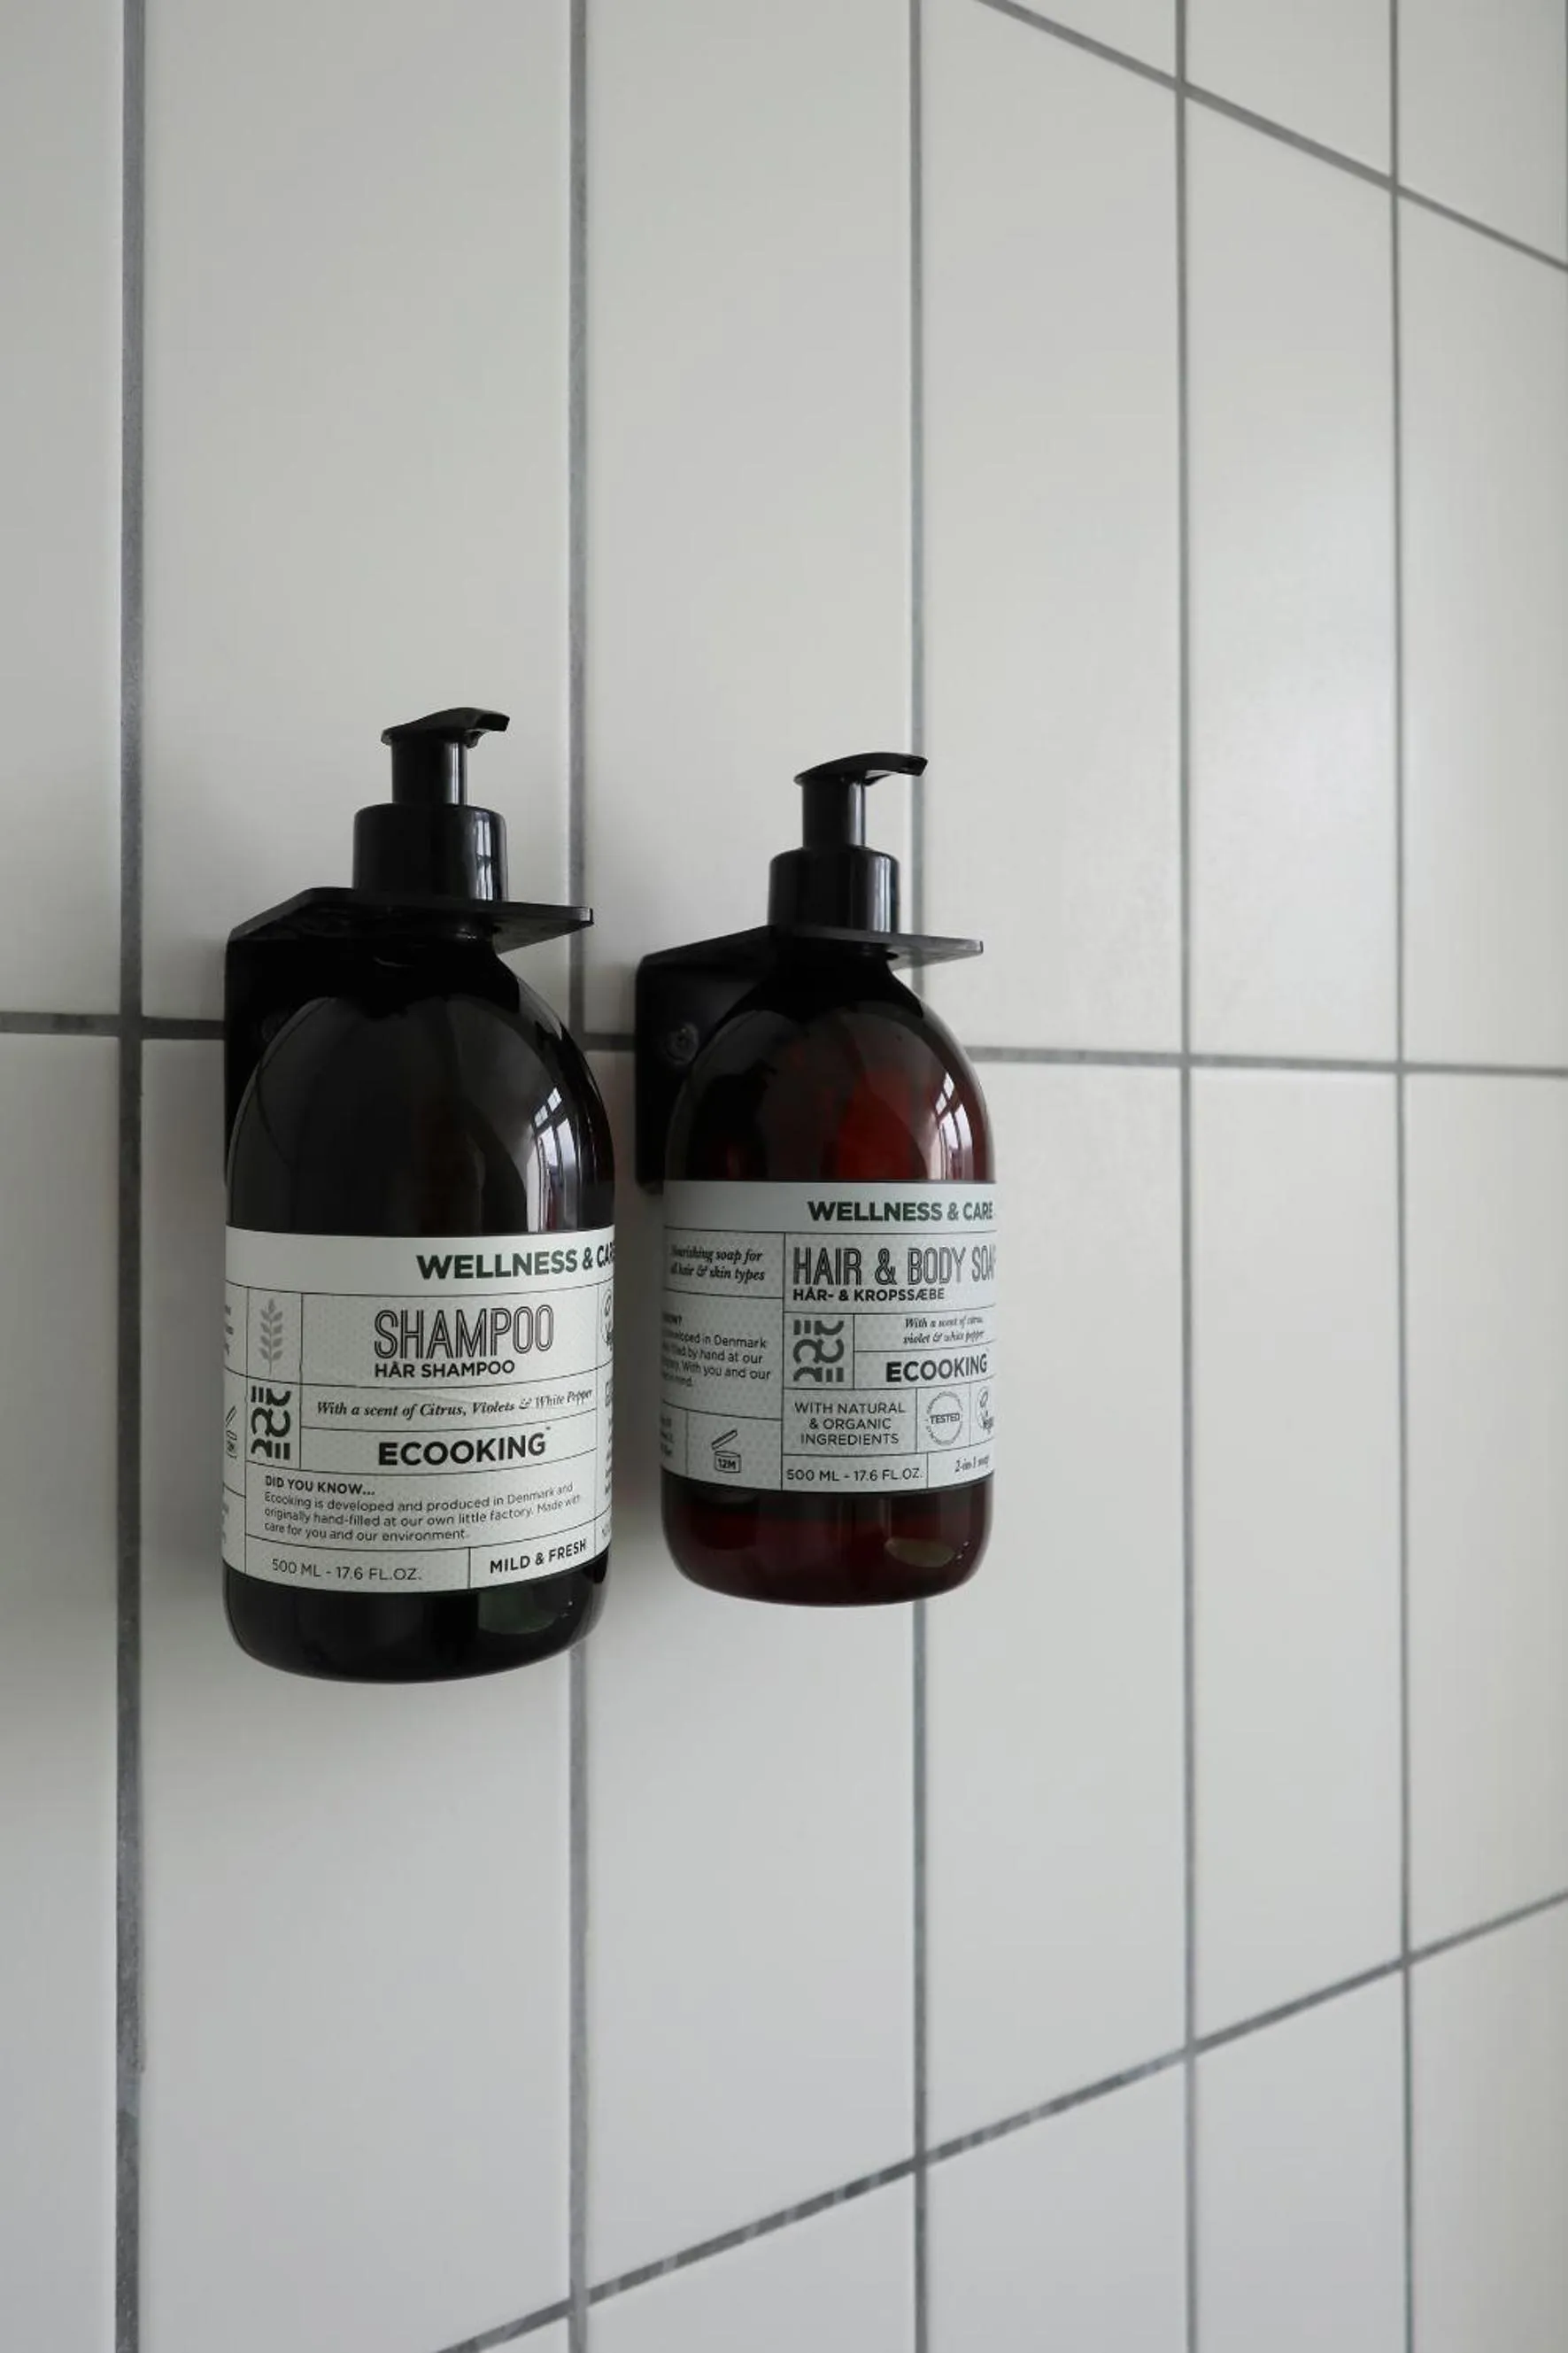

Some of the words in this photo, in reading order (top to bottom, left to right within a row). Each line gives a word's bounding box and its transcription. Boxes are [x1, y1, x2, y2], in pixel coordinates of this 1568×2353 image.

[807, 1201, 943, 1221] WELLNESS
[946, 1203, 959, 1220] &
[416, 1249, 577, 1280] WELLNESS
[583, 1247, 593, 1270] &
[716, 1250, 742, 1265] soap
[743, 1248, 762, 1265] for
[793, 1246, 862, 1285] HAIR
[874, 1247, 897, 1285] &
[907, 1246, 966, 1285] BODY
[971, 1243, 997, 1284] SOA
[697, 1265, 707, 1277] &
[709, 1266, 731, 1279] skin
[735, 1268, 765, 1284] types
[792, 1287, 834, 1301] HÅR-
[838, 1289, 849, 1301] &
[854, 1288, 946, 1302] KROPSSÆBE
[375, 1304, 554, 1359] SHAMPOO
[905, 1317, 927, 1328] With
[714, 1335, 767, 1348] Denmark
[903, 1332, 931, 1344] violet
[932, 1331, 943, 1343] &
[700, 1349, 725, 1361] hand
[727, 1351, 738, 1362] at
[742, 1354, 763, 1364] our
[375, 1361, 415, 1378] HÅR
[421, 1359, 515, 1378] SHAMPOO
[703, 1366, 722, 1377] you
[724, 1367, 745, 1378] and
[749, 1369, 771, 1380] our
[886, 1353, 987, 1382] ECOOKING
[317, 1401, 347, 1416] With
[351, 1405, 360, 1415] a
[364, 1405, 398, 1416] scent
[402, 1403, 417, 1420] of
[420, 1403, 467, 1417] Citrus,
[472, 1400, 514, 1414] Violets
[518, 1398, 531, 1410] &
[535, 1394, 565, 1410] White
[567, 1389, 593, 1406] Pepper
[794, 1402, 833, 1414] WITH
[838, 1401, 907, 1414] NATURAL
[809, 1418, 819, 1429] &
[823, 1417, 892, 1430] ORGANIC
[930, 1413, 960, 1425] TESTED
[800, 1433, 900, 1445] INGREDIENTS
[378, 1432, 545, 1466] ECOOKING
[266, 1474, 284, 1488] DID
[288, 1479, 313, 1492] YOU
[317, 1482, 375, 1496] KNOW...
[786, 1469, 815, 1482] 500
[820, 1469, 840, 1482] ML
[854, 1469, 878, 1482] 17.6
[265, 1491, 311, 1510] Ecooking
[314, 1498, 324, 1508] is
[327, 1500, 394, 1514] developed
[398, 1501, 422, 1512] and
[427, 1497, 490, 1514] produced
[493, 1494, 504, 1505] in
[507, 1485, 554, 1505] Denmark
[557, 1482, 574, 1495] and
[265, 1507, 310, 1524] originally
[313, 1513, 380, 1527] hand-filled
[383, 1516, 397, 1527] at
[400, 1517, 423, 1527] our
[427, 1515, 454, 1527] own
[459, 1511, 486, 1524] little
[537, 1501, 561, 1514] Made
[265, 1522, 285, 1534] care
[287, 1524, 302, 1536] for
[305, 1529, 327, 1539] you
[329, 1529, 352, 1540] and
[356, 1531, 378, 1542] our
[490, 1555, 530, 1574] MILD
[535, 1552, 545, 1566] &
[548, 1538, 588, 1562] FRESH
[272, 1559, 297, 1574] 500
[300, 1562, 321, 1577] ML
[336, 1567, 364, 1580] 17.6
